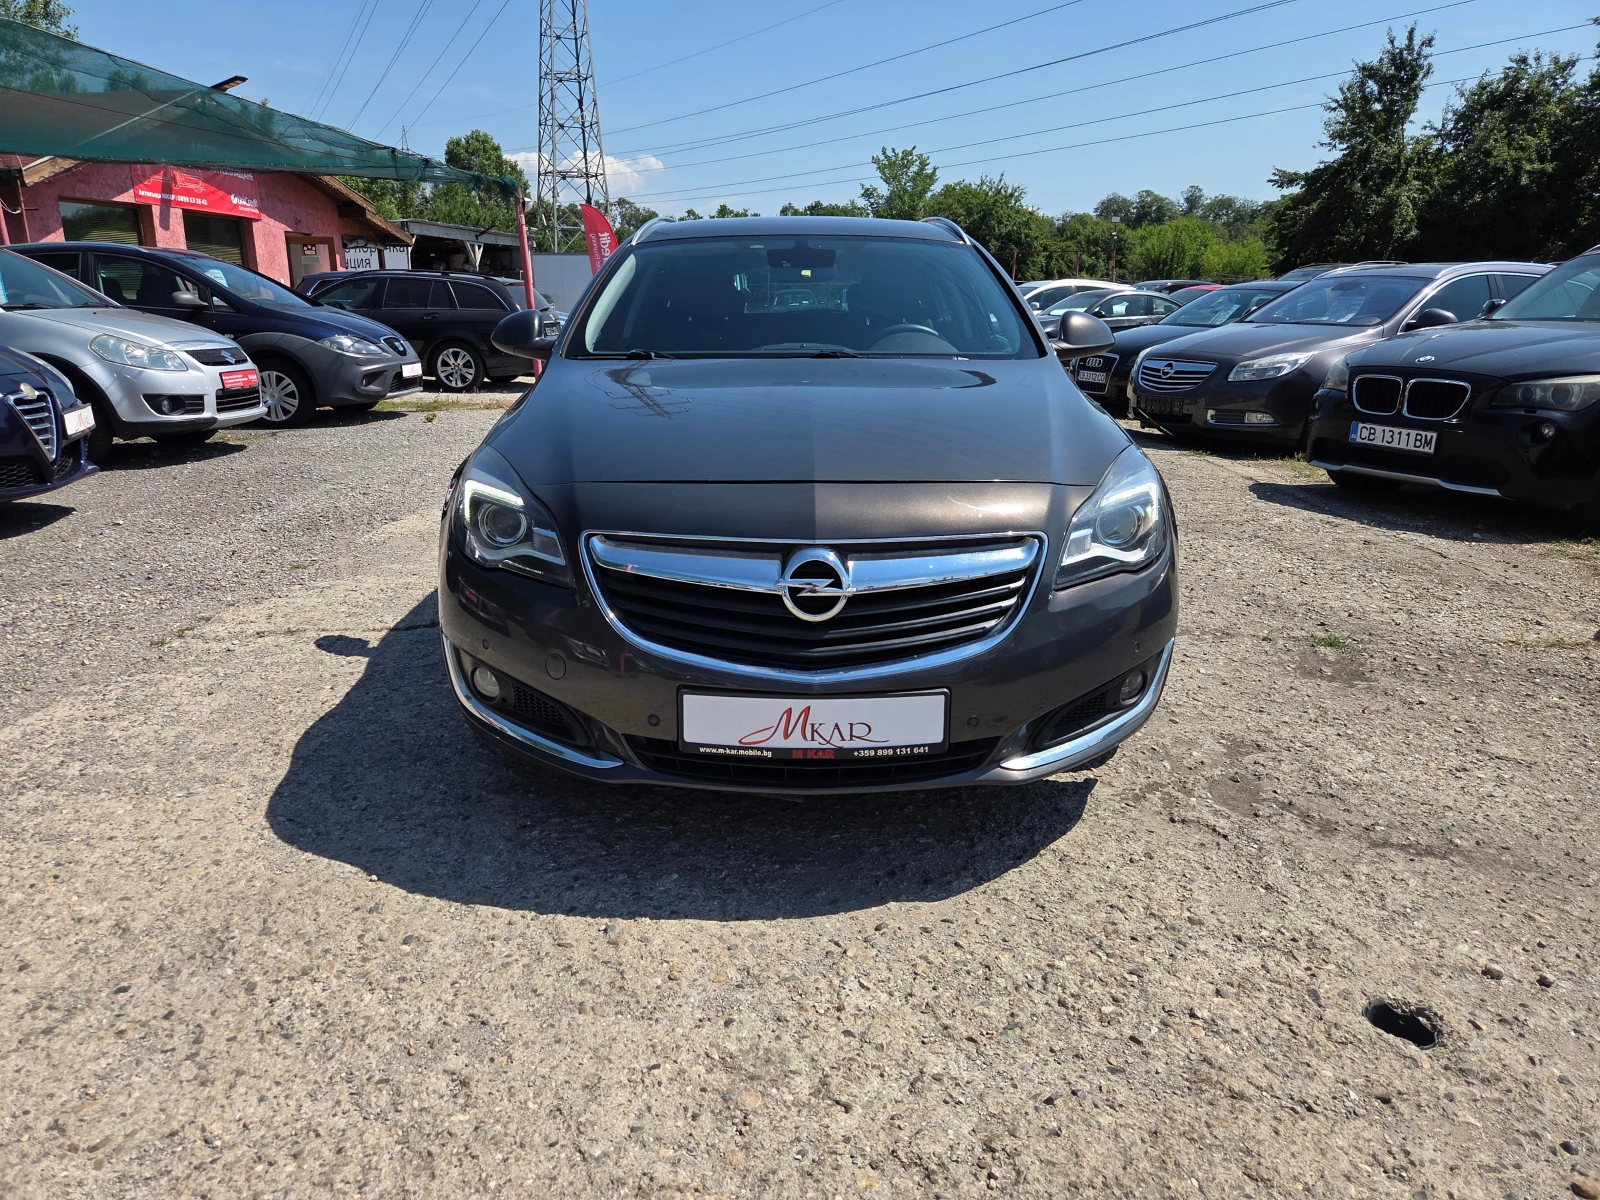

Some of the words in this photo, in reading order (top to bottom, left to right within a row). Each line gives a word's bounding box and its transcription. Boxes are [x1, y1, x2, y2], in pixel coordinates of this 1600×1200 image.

[1359, 426, 1376, 441] CB
[1382, 428, 1411, 447] 1311
[1413, 433, 1433, 450] BM
[699, 747, 772, 757] www.m-kar.mobile.bg
[792, 749, 803, 758] M
[806, 749, 835, 758] KAR
